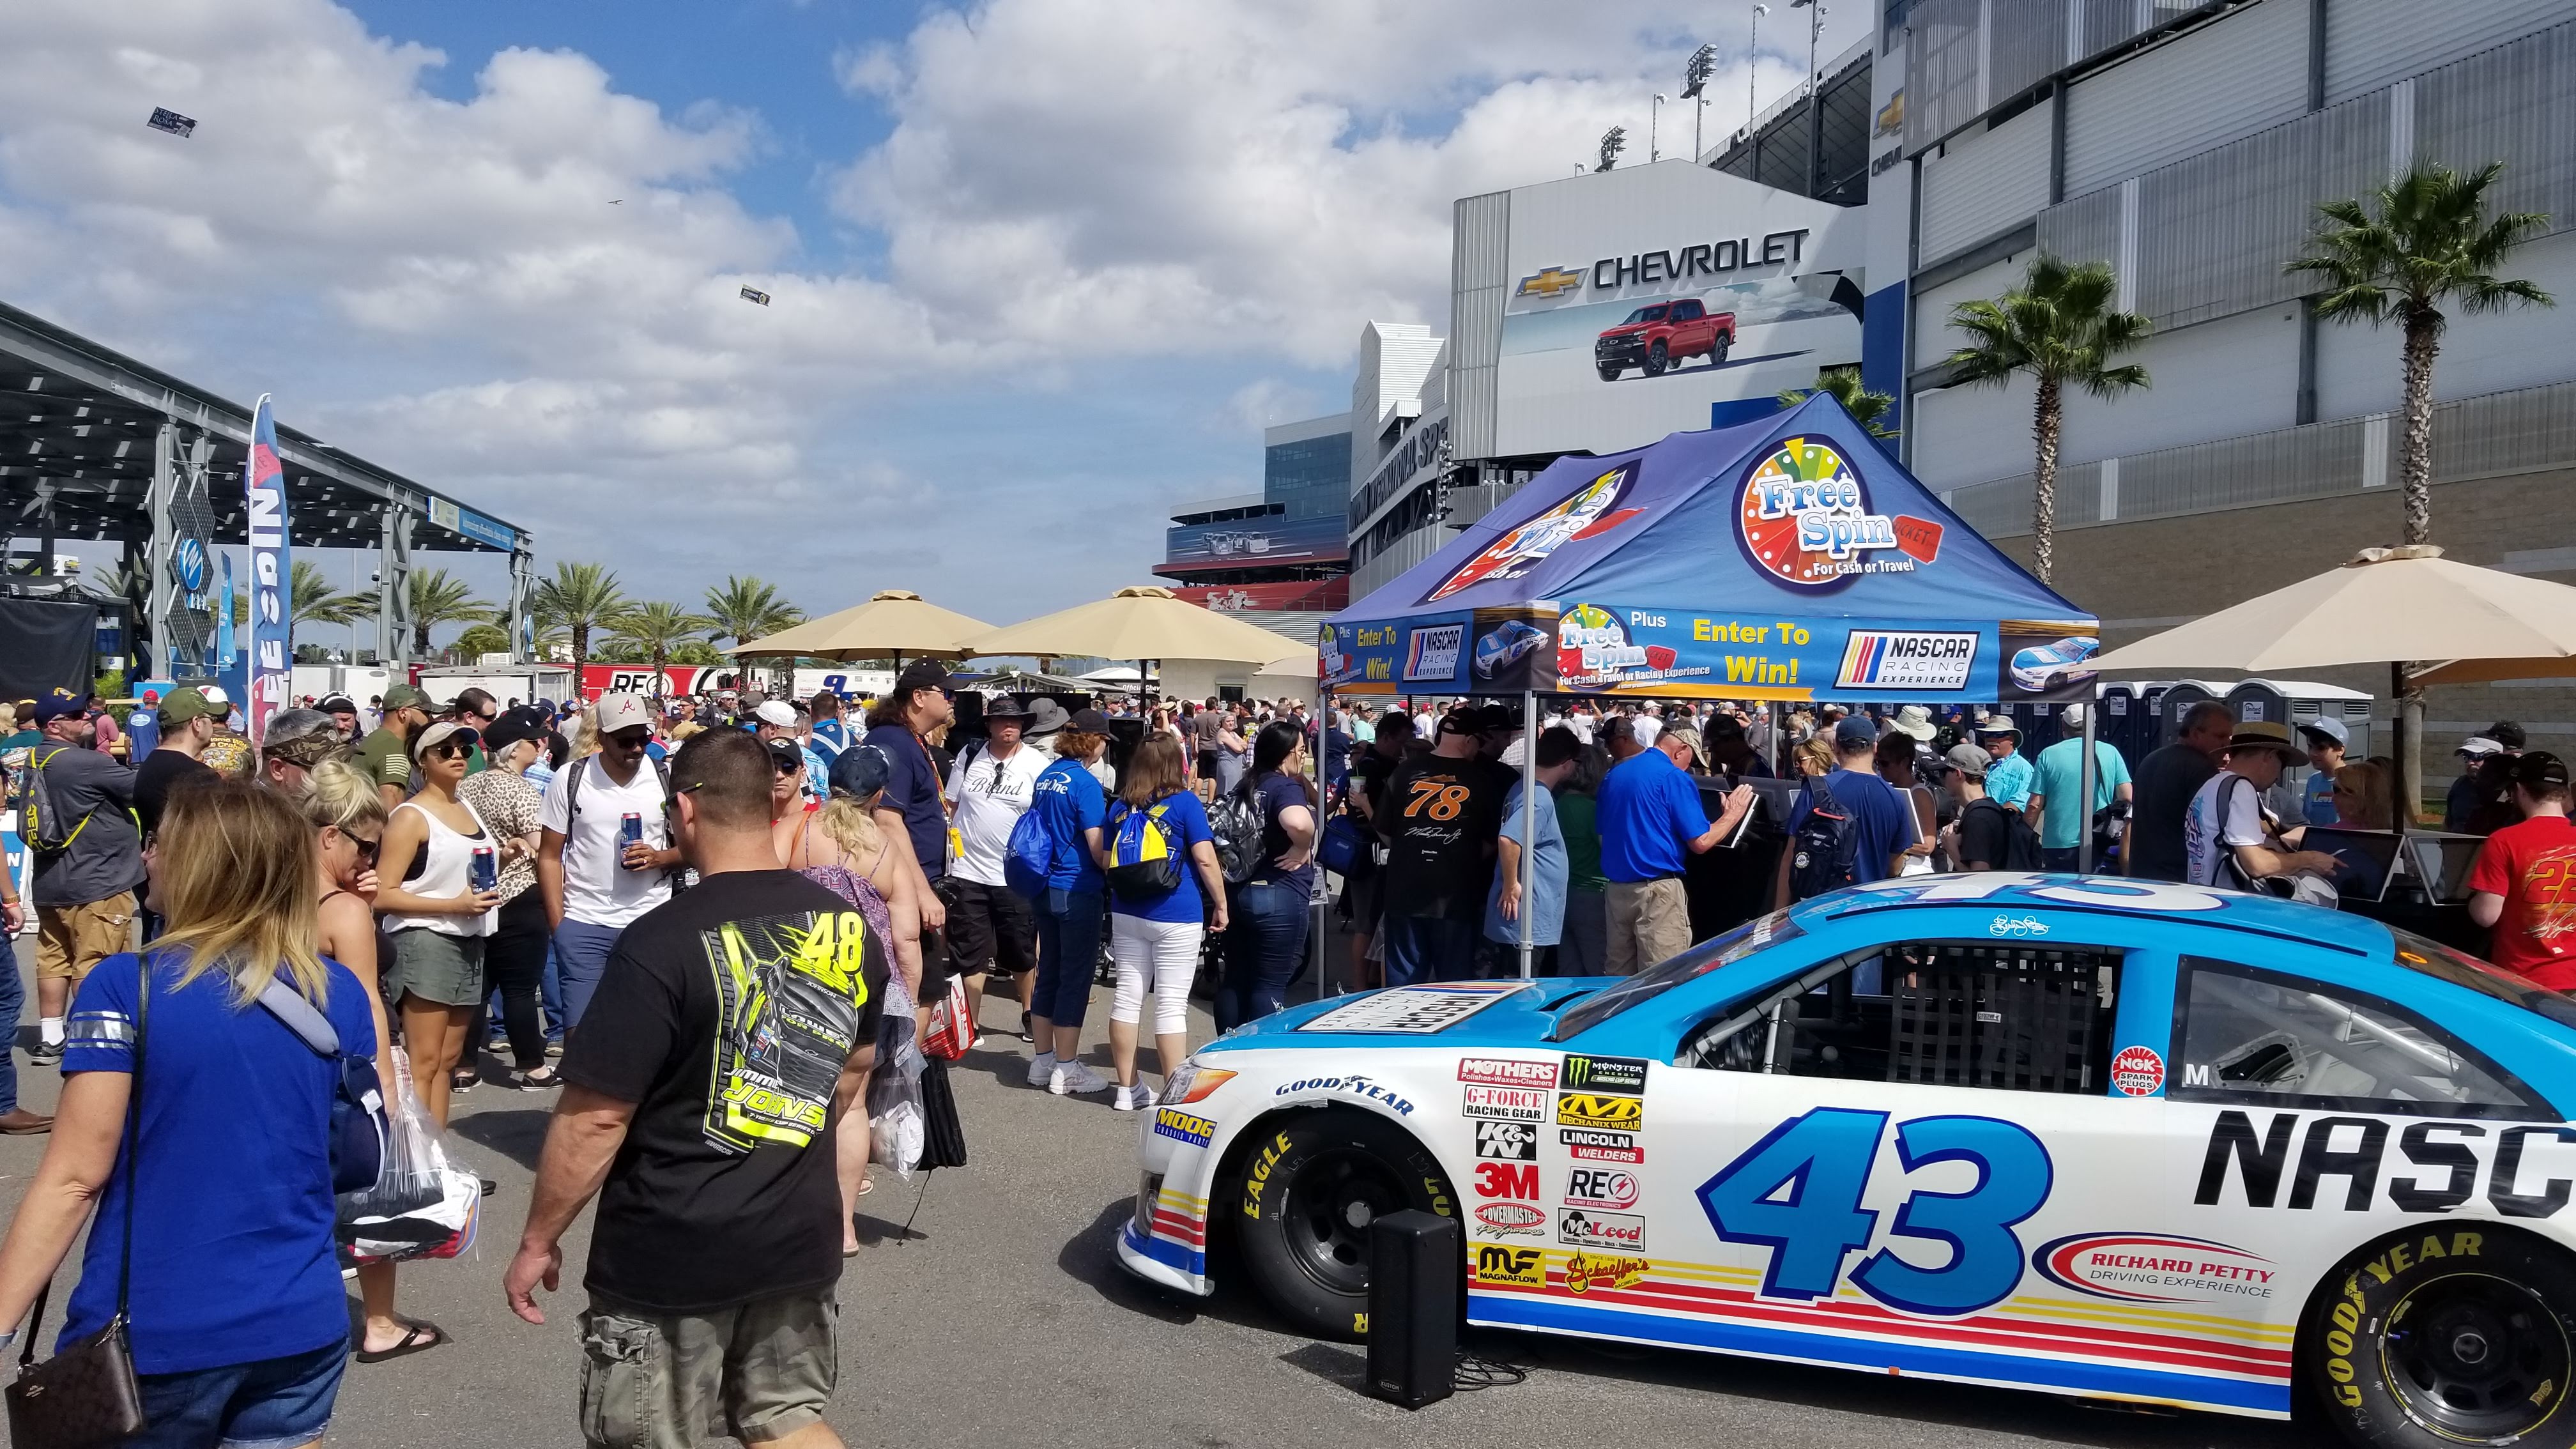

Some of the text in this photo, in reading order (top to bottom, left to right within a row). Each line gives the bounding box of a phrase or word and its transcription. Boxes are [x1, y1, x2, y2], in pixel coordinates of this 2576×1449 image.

[1594, 228, 1809, 290] CHEVROLET
[1760, 479, 1857, 514] Free
[1802, 511, 1893, 553] Spin
[253, 488, 282, 625] SPIN
[1813, 558, 1915, 576] For Cash or Travel
[1630, 611, 1667, 627] Plus
[1339, 626, 1351, 638] Plus
[1357, 625, 1397, 647] Enter To
[1425, 629, 1460, 652] NASCAR
[1562, 625, 1622, 646] Free
[1693, 618, 1810, 645] Enter To
[1422, 653, 1457, 664] RACING
[1584, 645, 1646, 670] Spin
[1889, 638, 1969, 658] NASCAR
[1366, 657, 1393, 680] Win!
[1419, 666, 1452, 676] EXPERIENCE
[1560, 675, 1573, 686] For
[1598, 671, 1624, 683] Travel
[1625, 672, 1634, 681] or
[1635, 670, 1663, 680] Racing
[1664, 666, 1710, 678] Experience
[1725, 656, 1798, 684] Win!
[1885, 661, 1965, 671] RACING
[821, 675, 848, 698] 9
[1882, 675, 1962, 684] EXPERIENCE
[618, 699, 635, 714] A
[1404, 781, 1470, 821] 78
[800, 911, 865, 973] 48
[708, 928, 735, 1040] JOHNSON
[806, 981, 836, 998] JOHNSON
[1317, 991, 1406, 1028] EXPERIENCE
[1345, 992, 1437, 1029] RACING
[1378, 994, 1492, 1030] NASCAR
[1462, 1059, 1556, 1080] MOTHERS
[1592, 1062, 1643, 1073] MONSTER
[2120, 1057, 2155, 1072] NGK
[2186, 1064, 2209, 1086] M
[1461, 1072, 1552, 1087] Polishes Waxes Cleaners
[2120, 1072, 2153, 1082] SPARK
[2120, 1080, 2153, 1089] PLUGS
[1275, 1076, 1414, 1117] GOODYEAR
[1468, 1087, 1542, 1108] G-FORCE
[1157, 1108, 1215, 1137] MOOG
[1466, 1105, 1541, 1119] RACING GEAR
[1558, 1114, 1641, 1131] MECHANIX WEAR
[1157, 1126, 1209, 1147] CHASSIS PARTS
[1563, 1132, 1629, 1147] LINCOLN
[1578, 1148, 1636, 1162] WELDERS
[2194, 1110, 2576, 1219] NASC
[1243, 1130, 1292, 1220] EAGLE
[1475, 1162, 1540, 1200] 3M
[1483, 1205, 1538, 1225] POWERMASTER
[1586, 1200, 1621, 1209] ELECTRONICS
[1695, 1106, 2054, 1315] 43
[1476, 1223, 1545, 1239] Performance
[1565, 1219, 1641, 1240] McLeod
[1480, 1272, 1538, 1284] MAGNAFLOW
[1566, 1257, 1650, 1283] Schaeffer's
[2090, 1253, 2276, 1283] RICHARD PETTY
[1614, 1279, 1633, 1289] RACING
[2090, 1270, 2273, 1298] DRIVING EXPERIENCE
[2327, 1232, 2483, 1407] GOODYEAR
